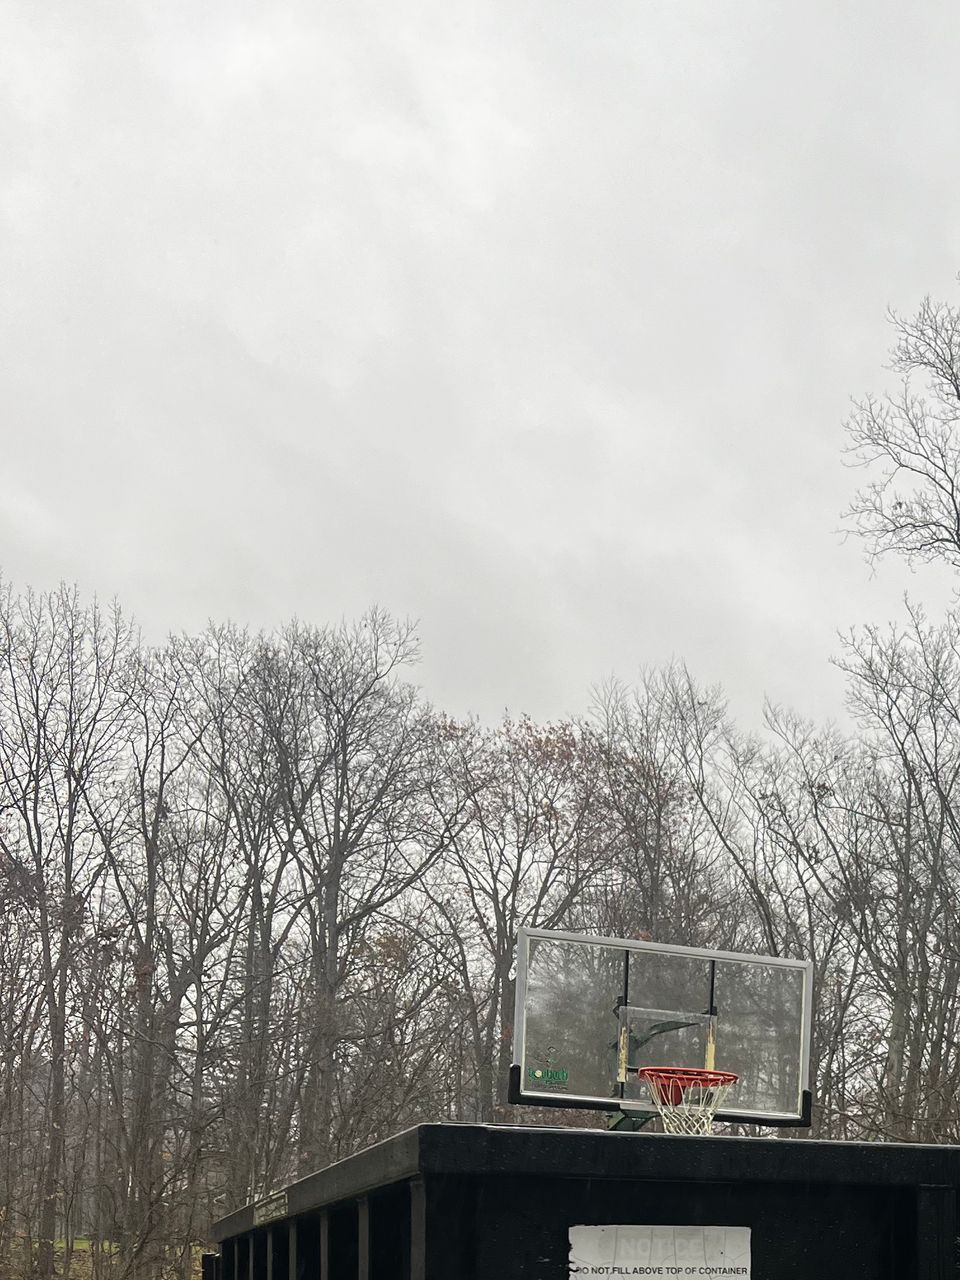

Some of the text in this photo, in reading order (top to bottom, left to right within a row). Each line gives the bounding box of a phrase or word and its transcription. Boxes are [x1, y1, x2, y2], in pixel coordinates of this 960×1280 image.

[591, 1267, 609, 1275] NOT
[612, 1267, 630, 1275] FILL
[633, 1267, 663, 1275] ABOVE
[666, 1267, 683, 1275] TOP
[685, 1267, 697, 1275] OF
[699, 1267, 748, 1275] CONTAINER
